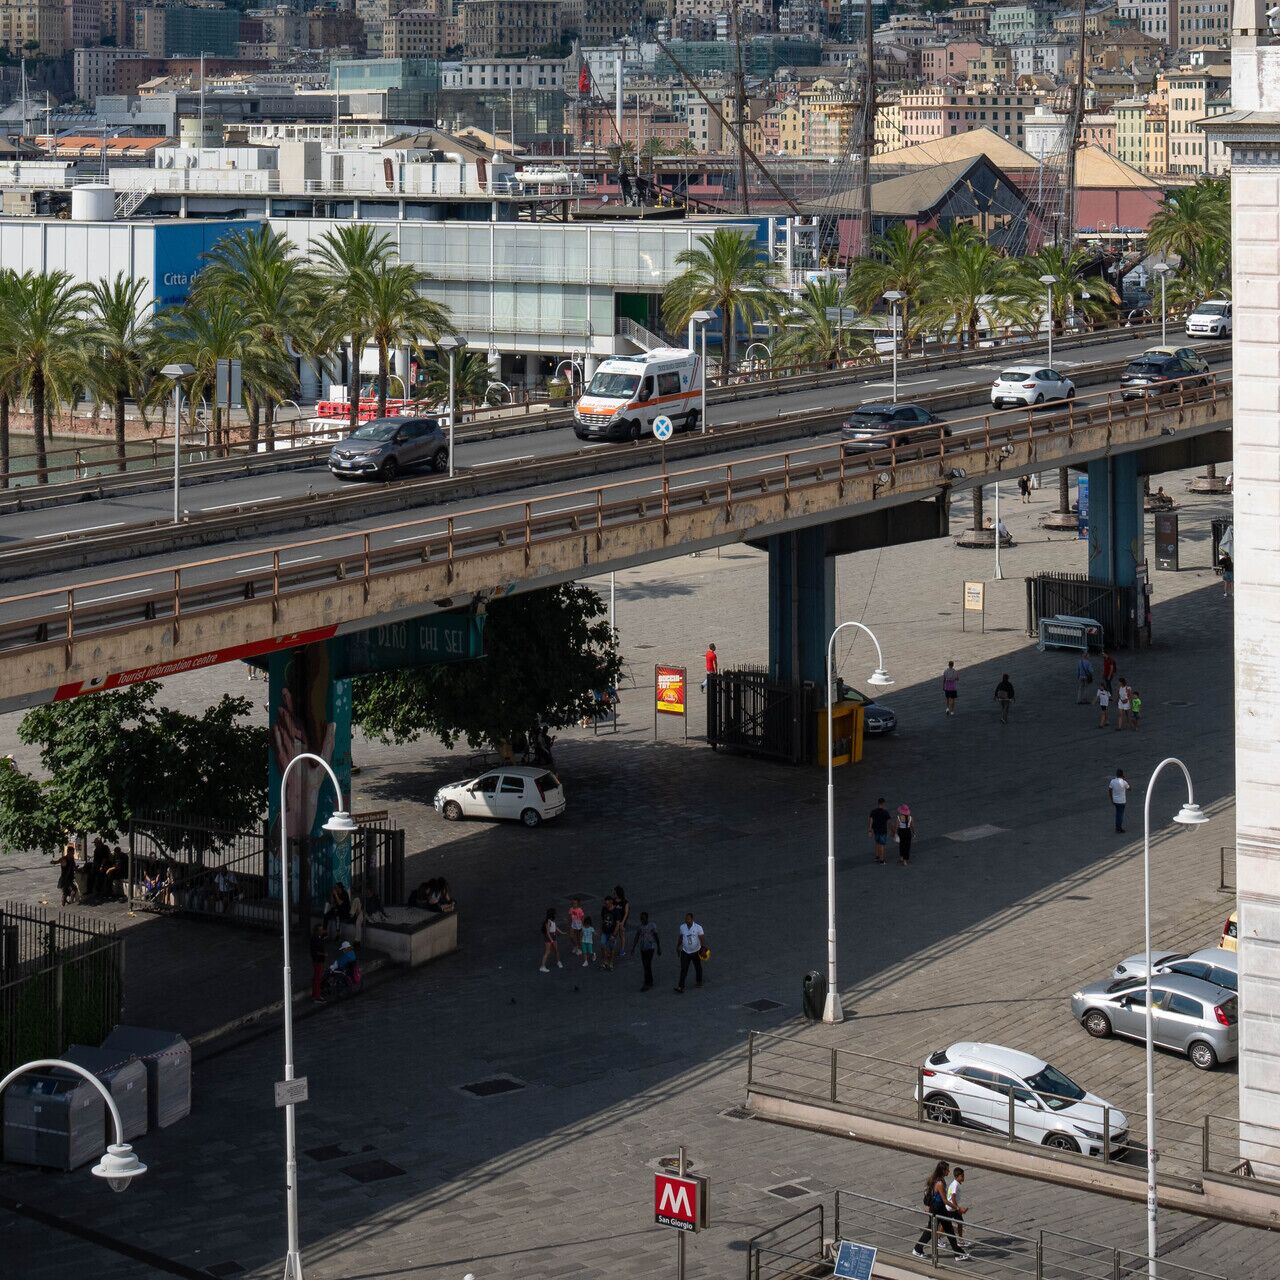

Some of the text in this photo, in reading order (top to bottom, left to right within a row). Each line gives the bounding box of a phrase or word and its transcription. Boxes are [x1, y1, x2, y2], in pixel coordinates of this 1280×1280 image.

[164, 272, 187, 286] Città
[419, 625, 439, 651] CHI
[444, 629, 465, 654] SEI
[118, 654, 218, 684] Tourist information centre
[659, 1183, 692, 1217] M
[658, 1215, 692, 1229] San Giorgio
